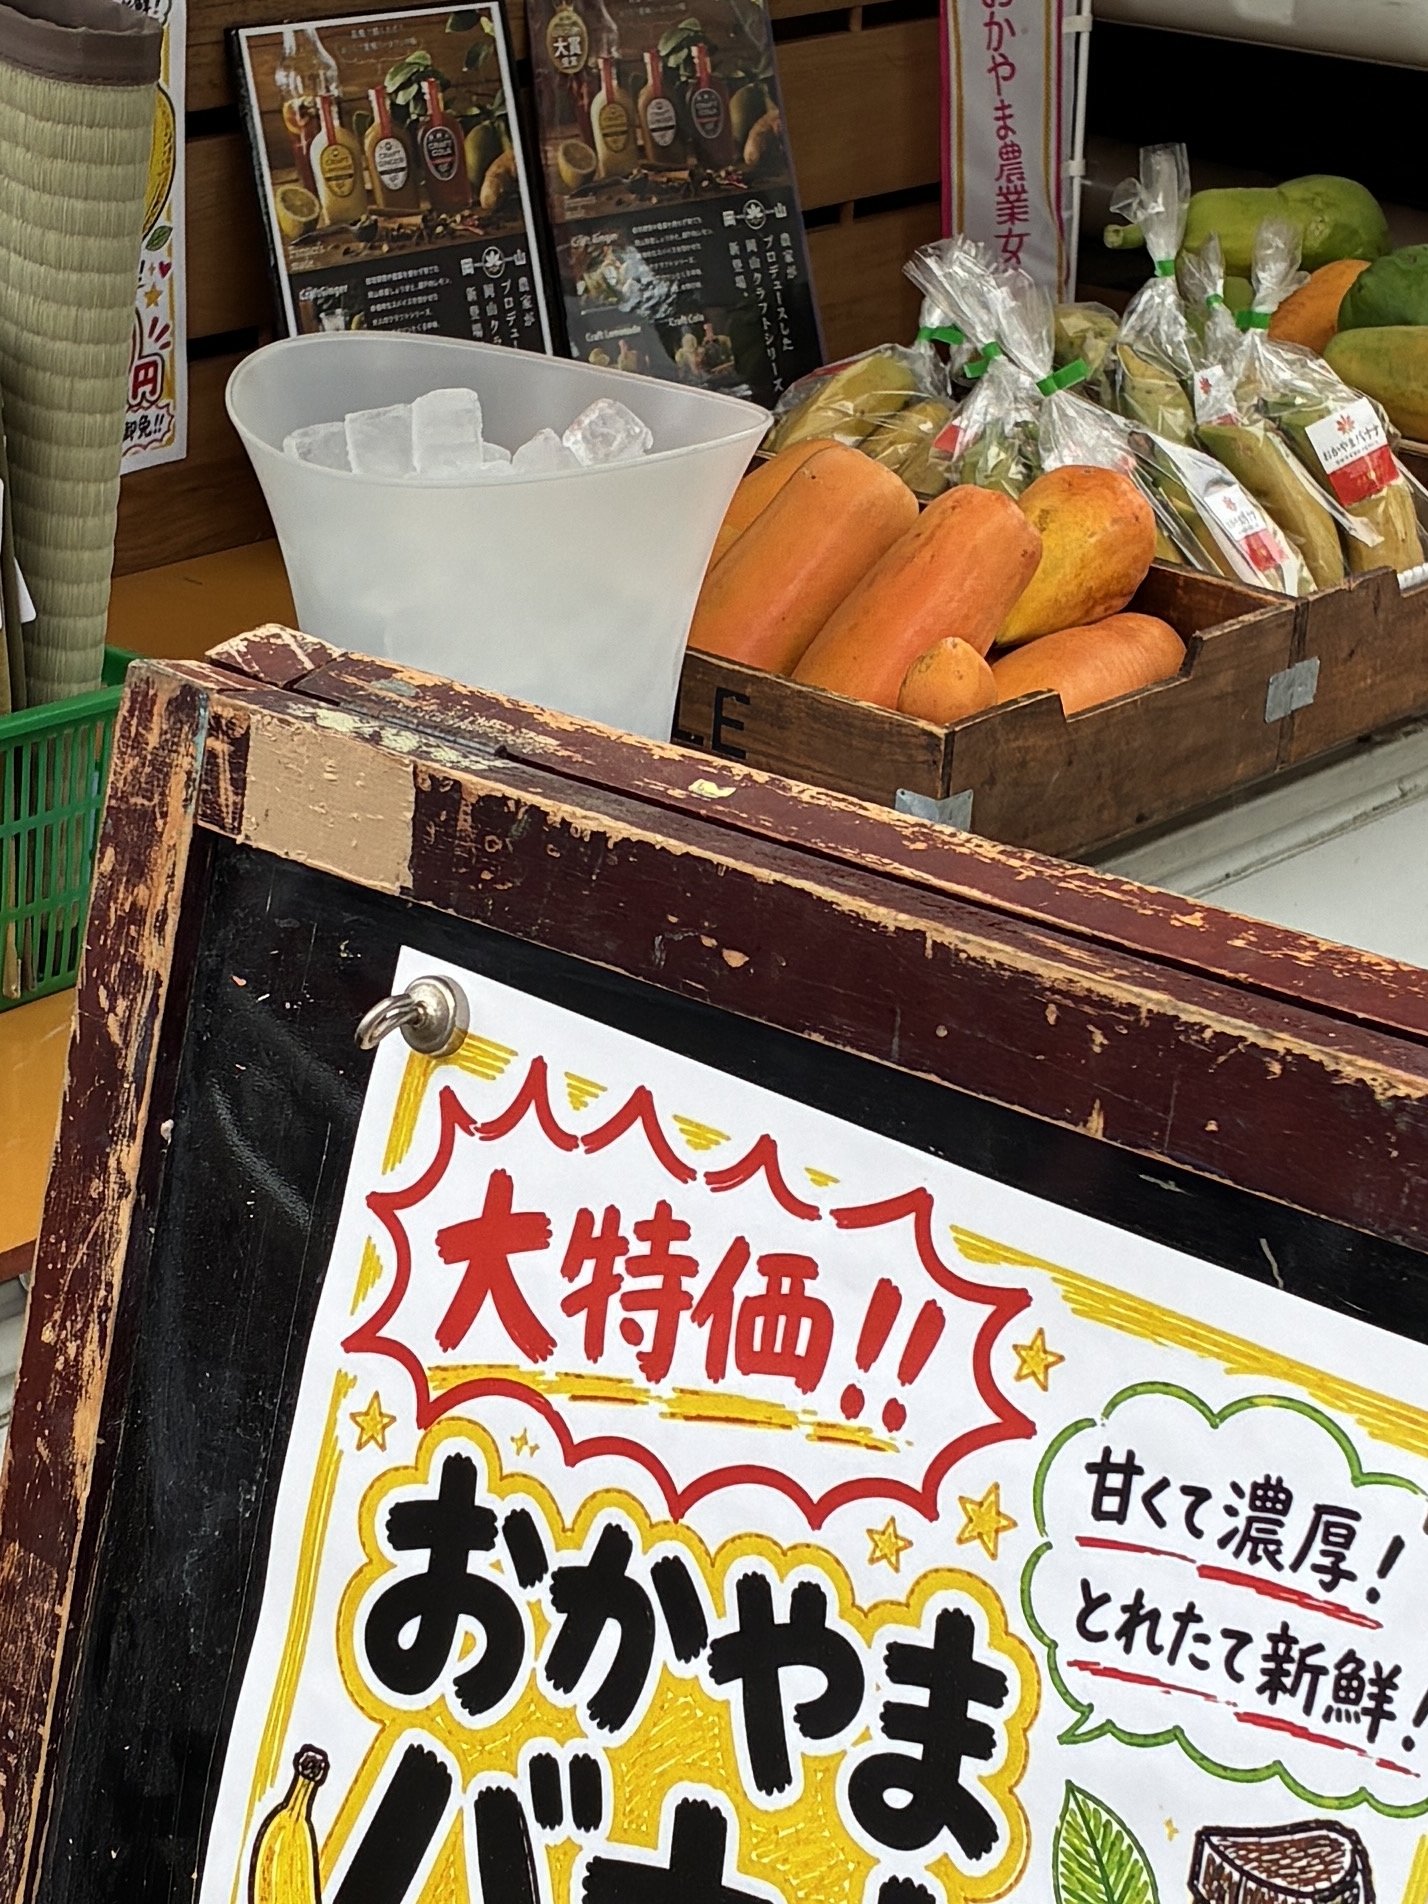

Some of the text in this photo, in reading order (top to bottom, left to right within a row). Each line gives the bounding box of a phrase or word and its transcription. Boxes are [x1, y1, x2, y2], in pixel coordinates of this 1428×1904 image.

[435, 1168, 946, 1433] 大特価!!
[364, 1452, 1009, 1860] おかやま
[1083, 1445, 1410, 1606] 甘くて濃厚!
